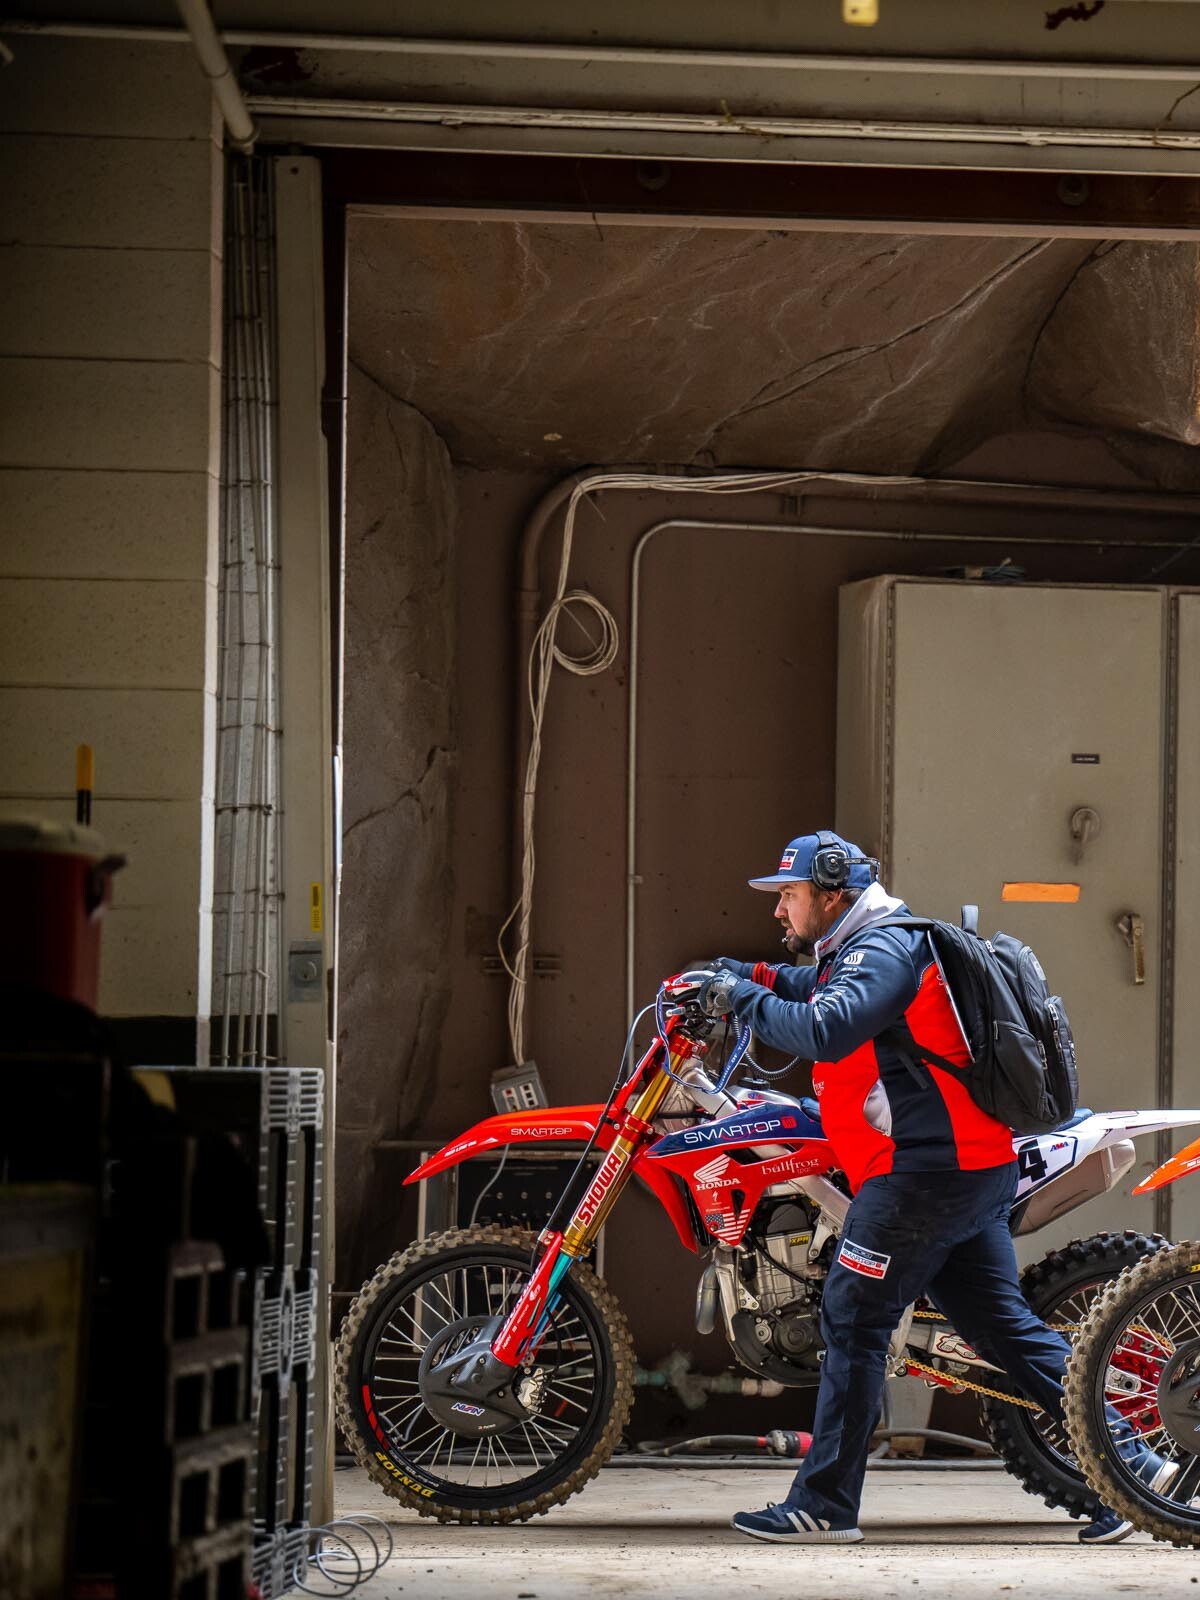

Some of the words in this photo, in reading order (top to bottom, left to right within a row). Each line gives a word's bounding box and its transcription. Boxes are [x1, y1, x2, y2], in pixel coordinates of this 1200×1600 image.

[510, 1127, 573, 1137] SMARTOP
[684, 1119, 781, 1144] SMARTOP
[1050, 1142, 1069, 1152] AMA
[761, 1157, 819, 1175] bullfrog
[577, 1153, 622, 1227] SHOWA
[696, 1178, 741, 1191] HONDA
[791, 1236, 809, 1244] XPR
[376, 1452, 435, 1497] DUNLOP
